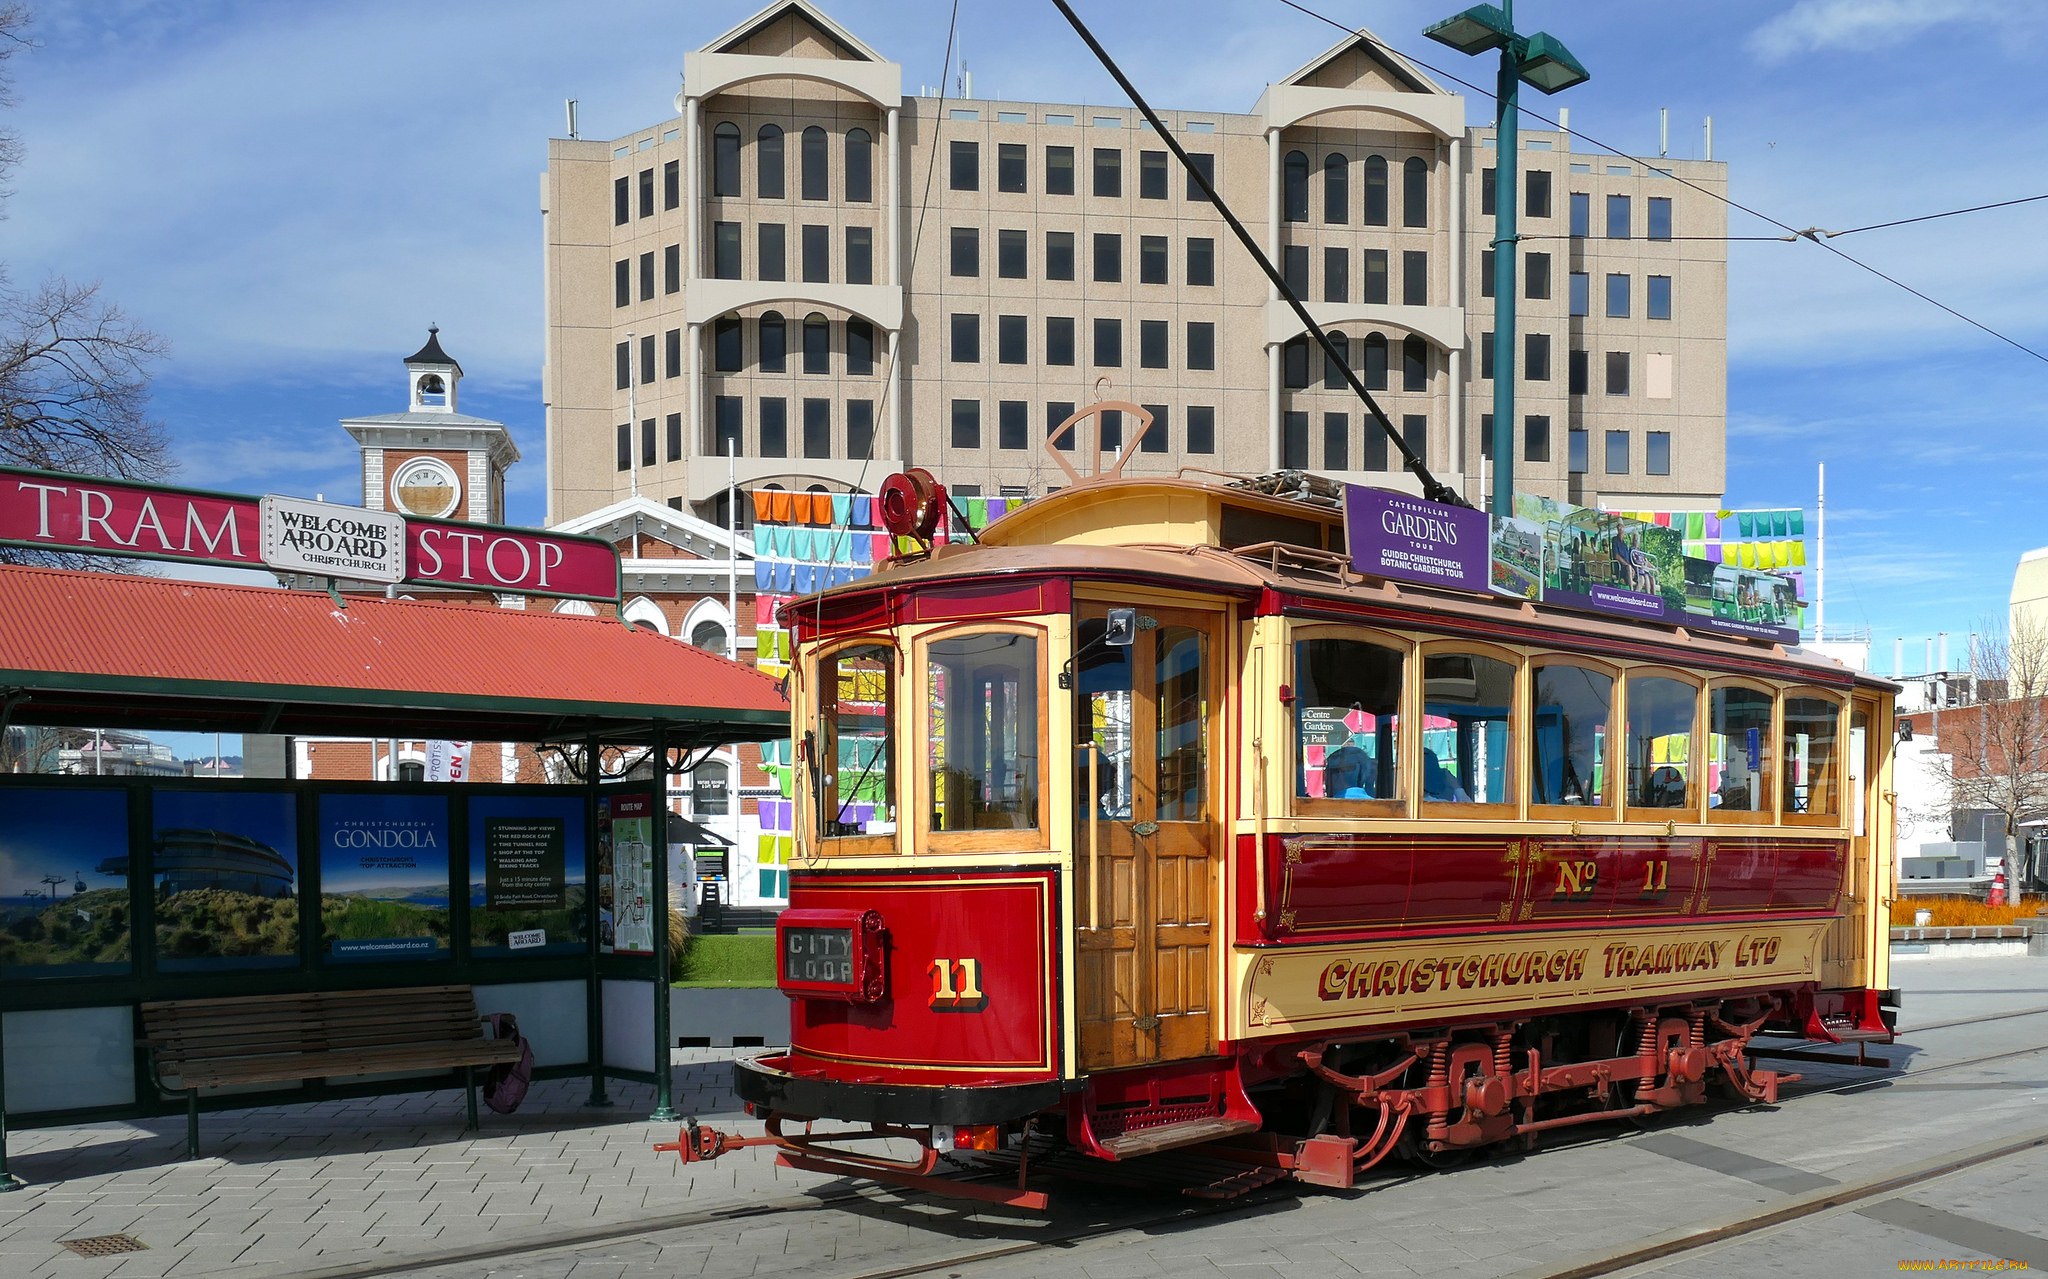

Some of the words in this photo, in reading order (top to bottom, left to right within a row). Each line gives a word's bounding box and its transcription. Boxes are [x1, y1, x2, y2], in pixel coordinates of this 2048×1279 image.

[1388, 499, 1449, 518] CATERPILLAR
[18, 481, 246, 557] TRAM
[418, 528, 564, 587] STOP
[278, 510, 387, 541] WELCOME
[1381, 509, 1457, 545] GARDENS
[279, 528, 388, 560] ABOARD
[1409, 540, 1434, 551] TOUR
[301, 553, 386, 572] CHRISTCHURCH
[1380, 557, 1412, 570] BOTANIC
[1412, 562, 1445, 576] GARDENS
[1445, 567, 1464, 579] TOUR
[1381, 548, 1409, 561] GUIDED
[1409, 553, 1462, 570] CHRISTCHURCH
[1306, 709, 1331, 719] Centre
[1304, 721, 1334, 731] Gardens
[1311, 734, 1327, 743] Park
[620, 802, 634, 811] ROUTE
[633, 802, 643, 811] MAP
[334, 829, 437, 848] GONDOLA
[1641, 861, 1669, 896] 11
[512, 932, 541, 940] WELCOME
[513, 937, 542, 946] ABOARD
[789, 934, 853, 956] CITY
[340, 942, 430, 951] www.welcomeaboard.co.nz
[789, 959, 853, 982] LOOP
[1317, 949, 1589, 1000] CHRISTCHURCH
[1603, 939, 1731, 978] TRAMWAY
[1735, 935, 1782, 966] LTD
[927, 958, 985, 1007] 11
